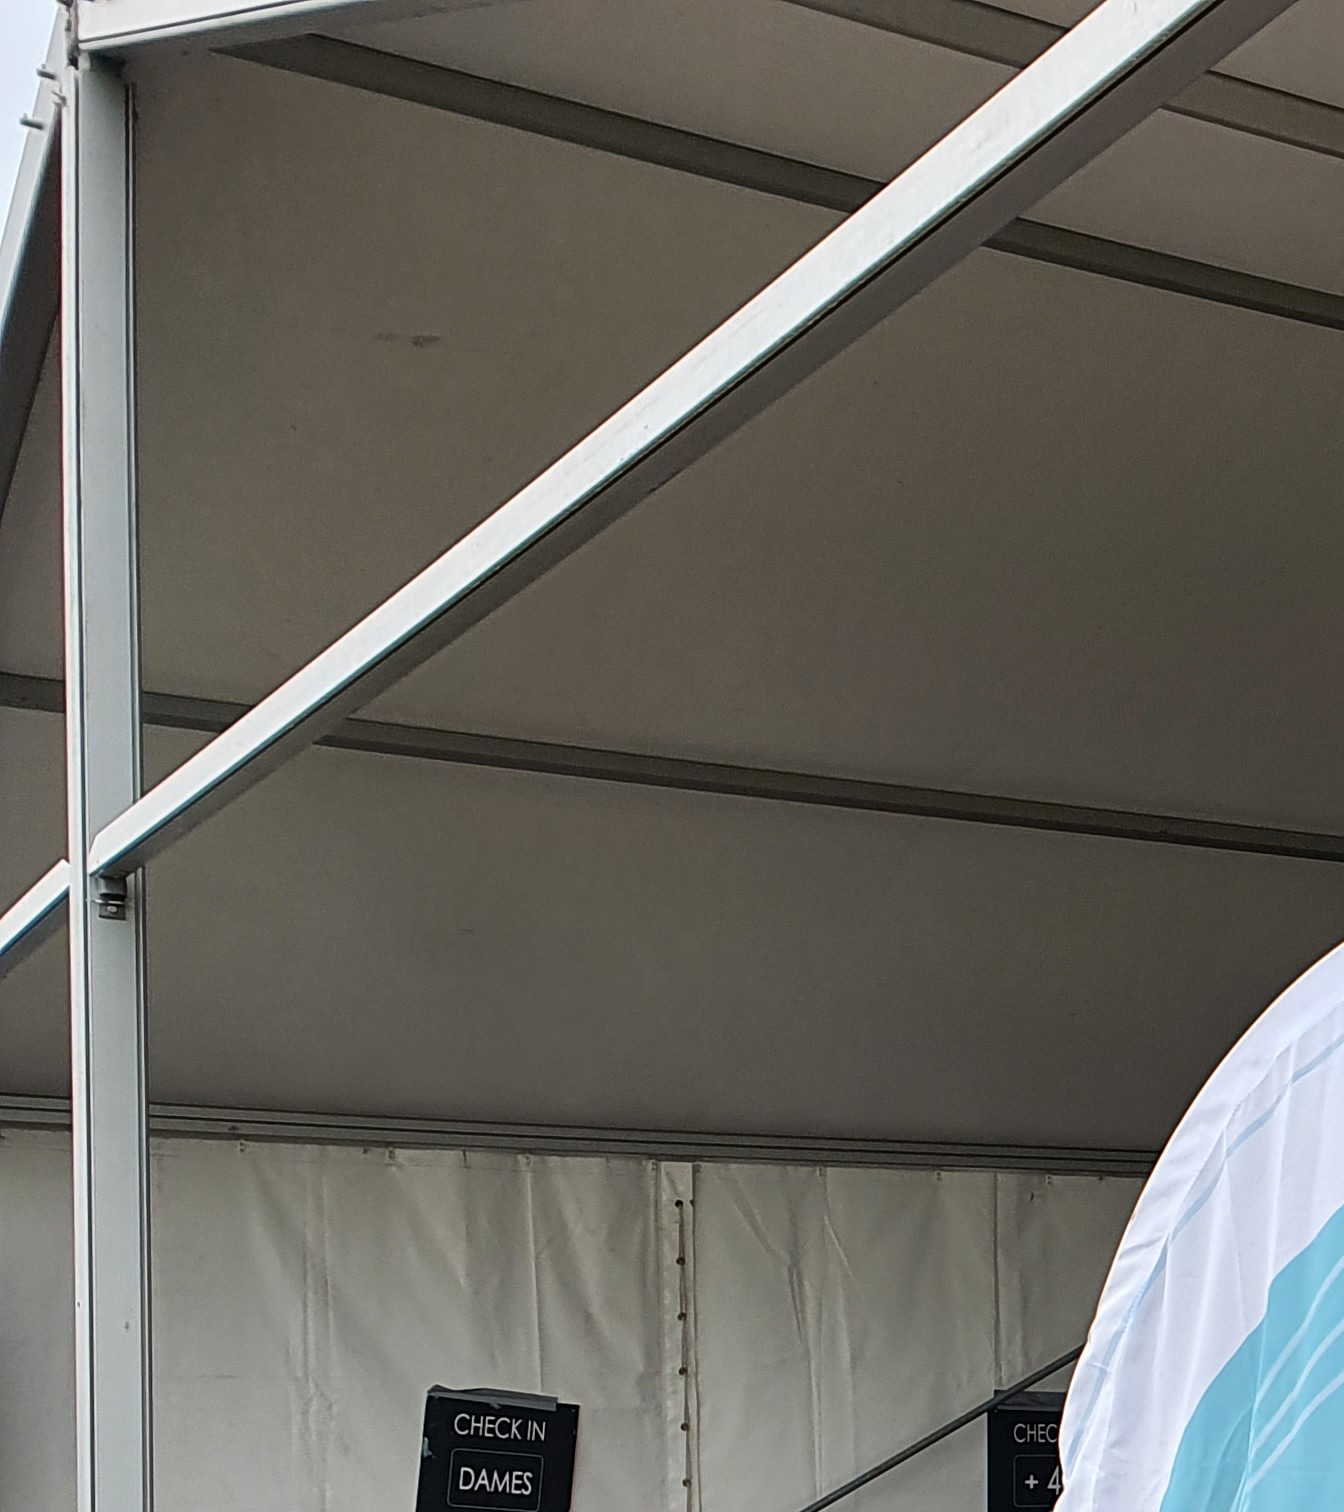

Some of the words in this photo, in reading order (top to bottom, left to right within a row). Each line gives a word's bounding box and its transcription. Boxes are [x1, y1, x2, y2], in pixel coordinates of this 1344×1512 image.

[453, 1413, 522, 1440] CHECK
[526, 1420, 546, 1441] IN
[1013, 1423, 1058, 1443] CHEC
[458, 1466, 534, 1495] DAMES
[1046, 1464, 1063, 1496] 4
